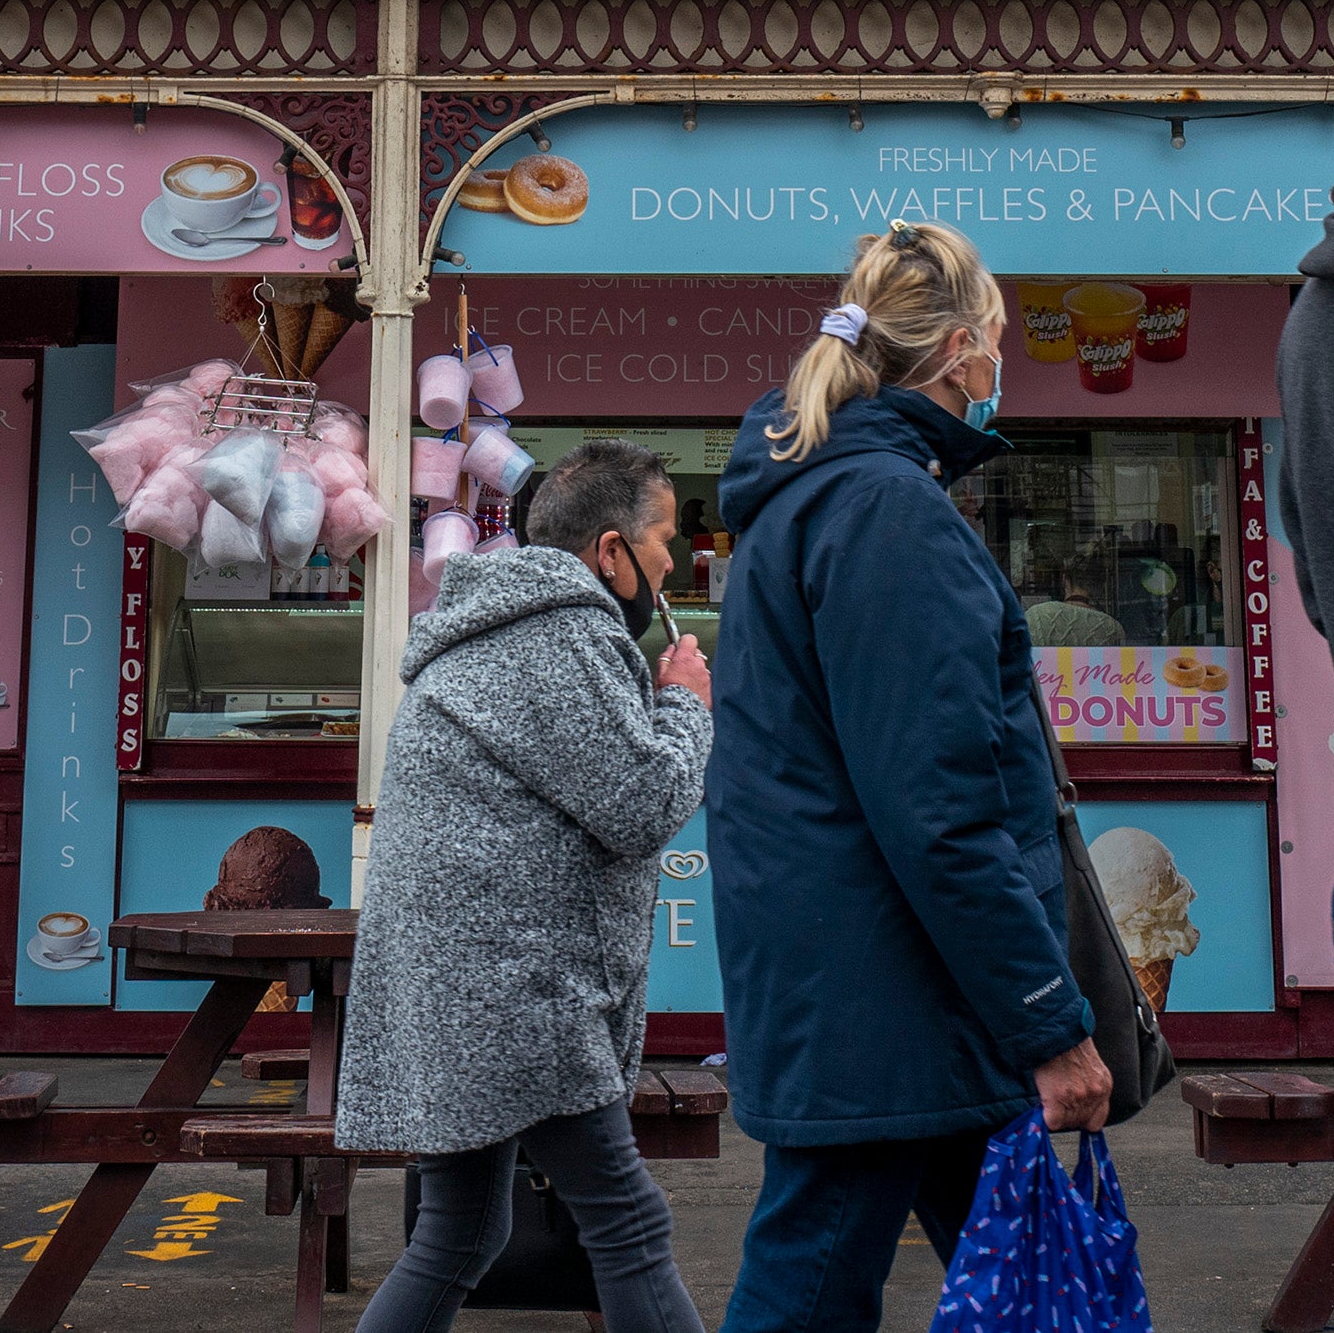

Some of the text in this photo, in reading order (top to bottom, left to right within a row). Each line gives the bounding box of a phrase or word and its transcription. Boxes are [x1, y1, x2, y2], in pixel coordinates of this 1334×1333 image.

[878, 147, 1098, 173] FRESHLY MADE
[630, 185, 1332, 226] DONUTS, WAFFLES & PANCAKE
[444, 307, 825, 337] ICE CREAM CAND
[546, 354, 603, 383] ICE
[630, 354, 730, 383] COLD
[1091, 362, 1123, 373] Slush
[1245, 518, 1264, 541] &
[1247, 559, 1273, 749] COFFEE
[60, 473, 98, 869] Hot Drinks
[120, 593, 143, 753] FLOSS
[1074, 660, 1156, 686] Made
[1049, 695, 1227, 728] DONUTS
